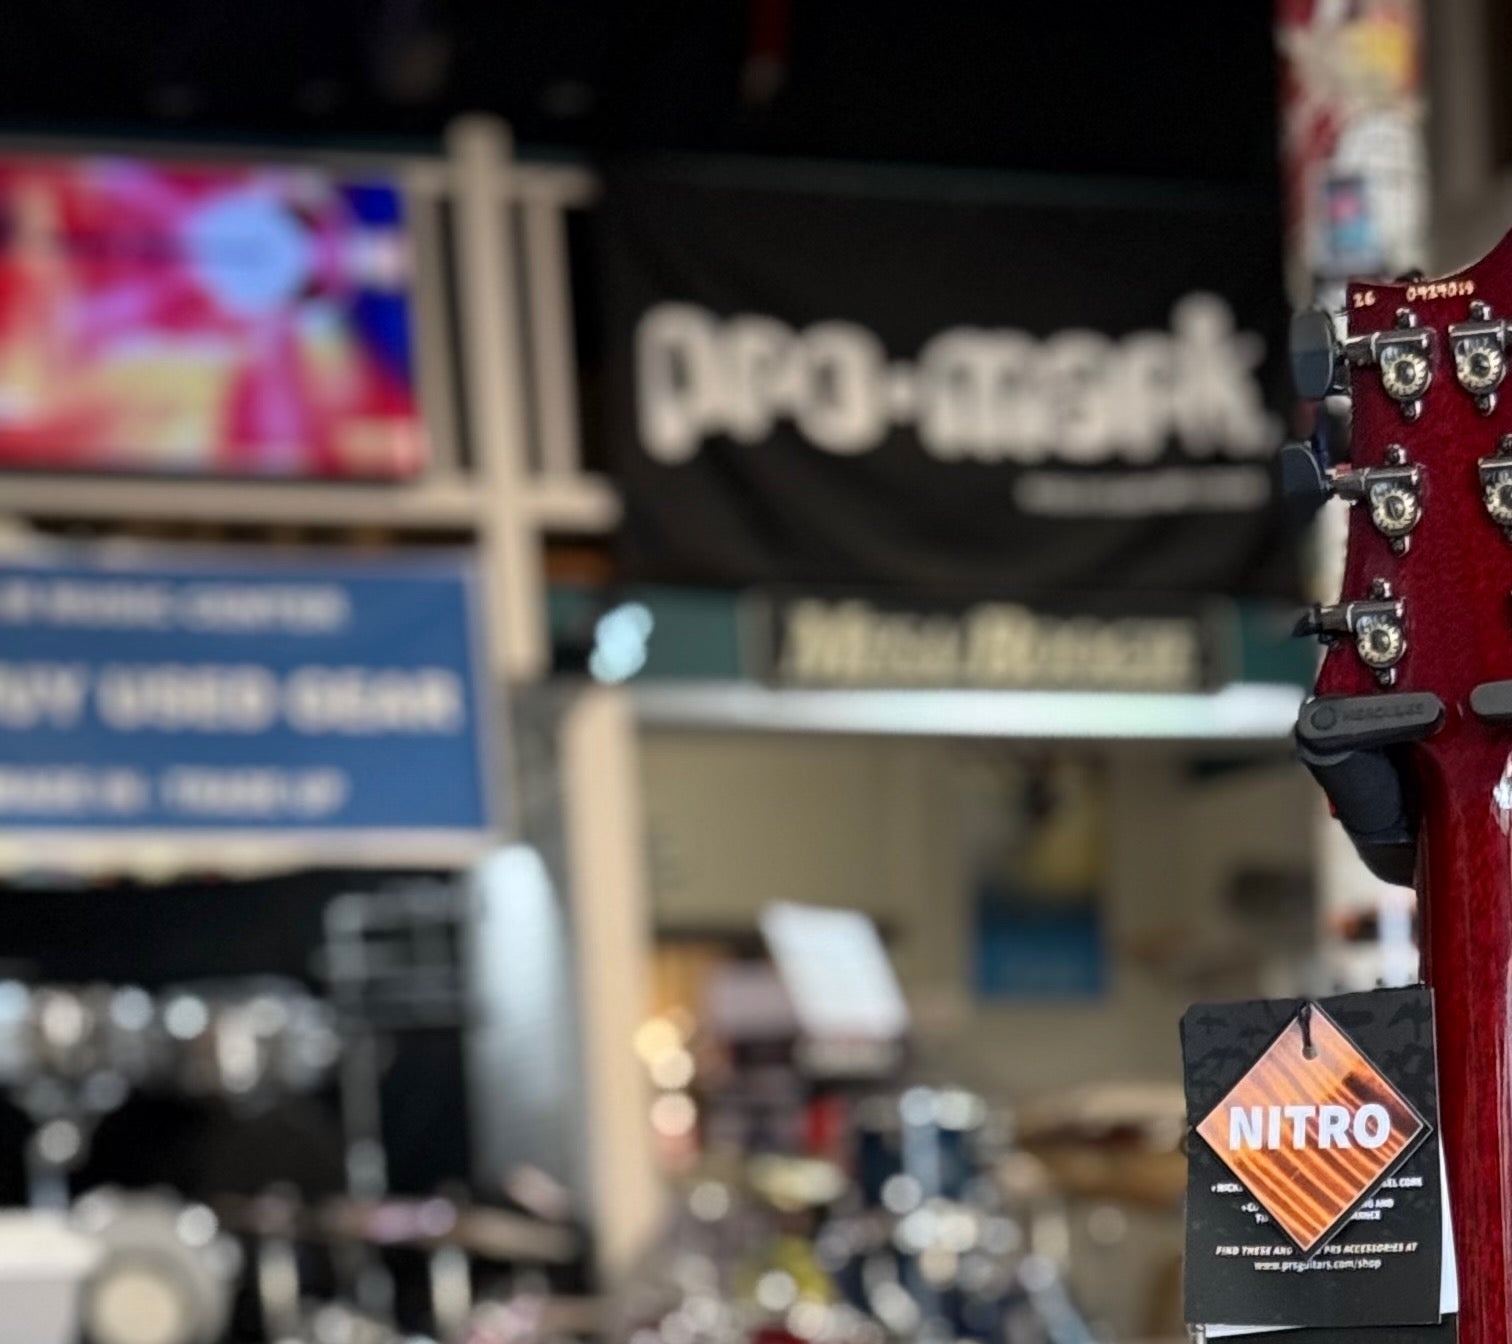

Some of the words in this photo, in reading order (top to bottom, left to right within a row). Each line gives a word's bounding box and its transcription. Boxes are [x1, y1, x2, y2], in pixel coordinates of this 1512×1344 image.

[286, 665, 464, 736] GEAR
[1229, 1103, 1391, 1150] NITRO
[1215, 1245, 1240, 1256] FIND
[1242, 1245, 1273, 1256] THESE
[1273, 1246, 1294, 1256] AND
[1324, 1244, 1342, 1255] PRS
[1343, 1242, 1404, 1255] ACCESSORIES
[1405, 1241, 1418, 1252] AT
[1253, 1259, 1382, 1273] www.prsguitars.com/shop
